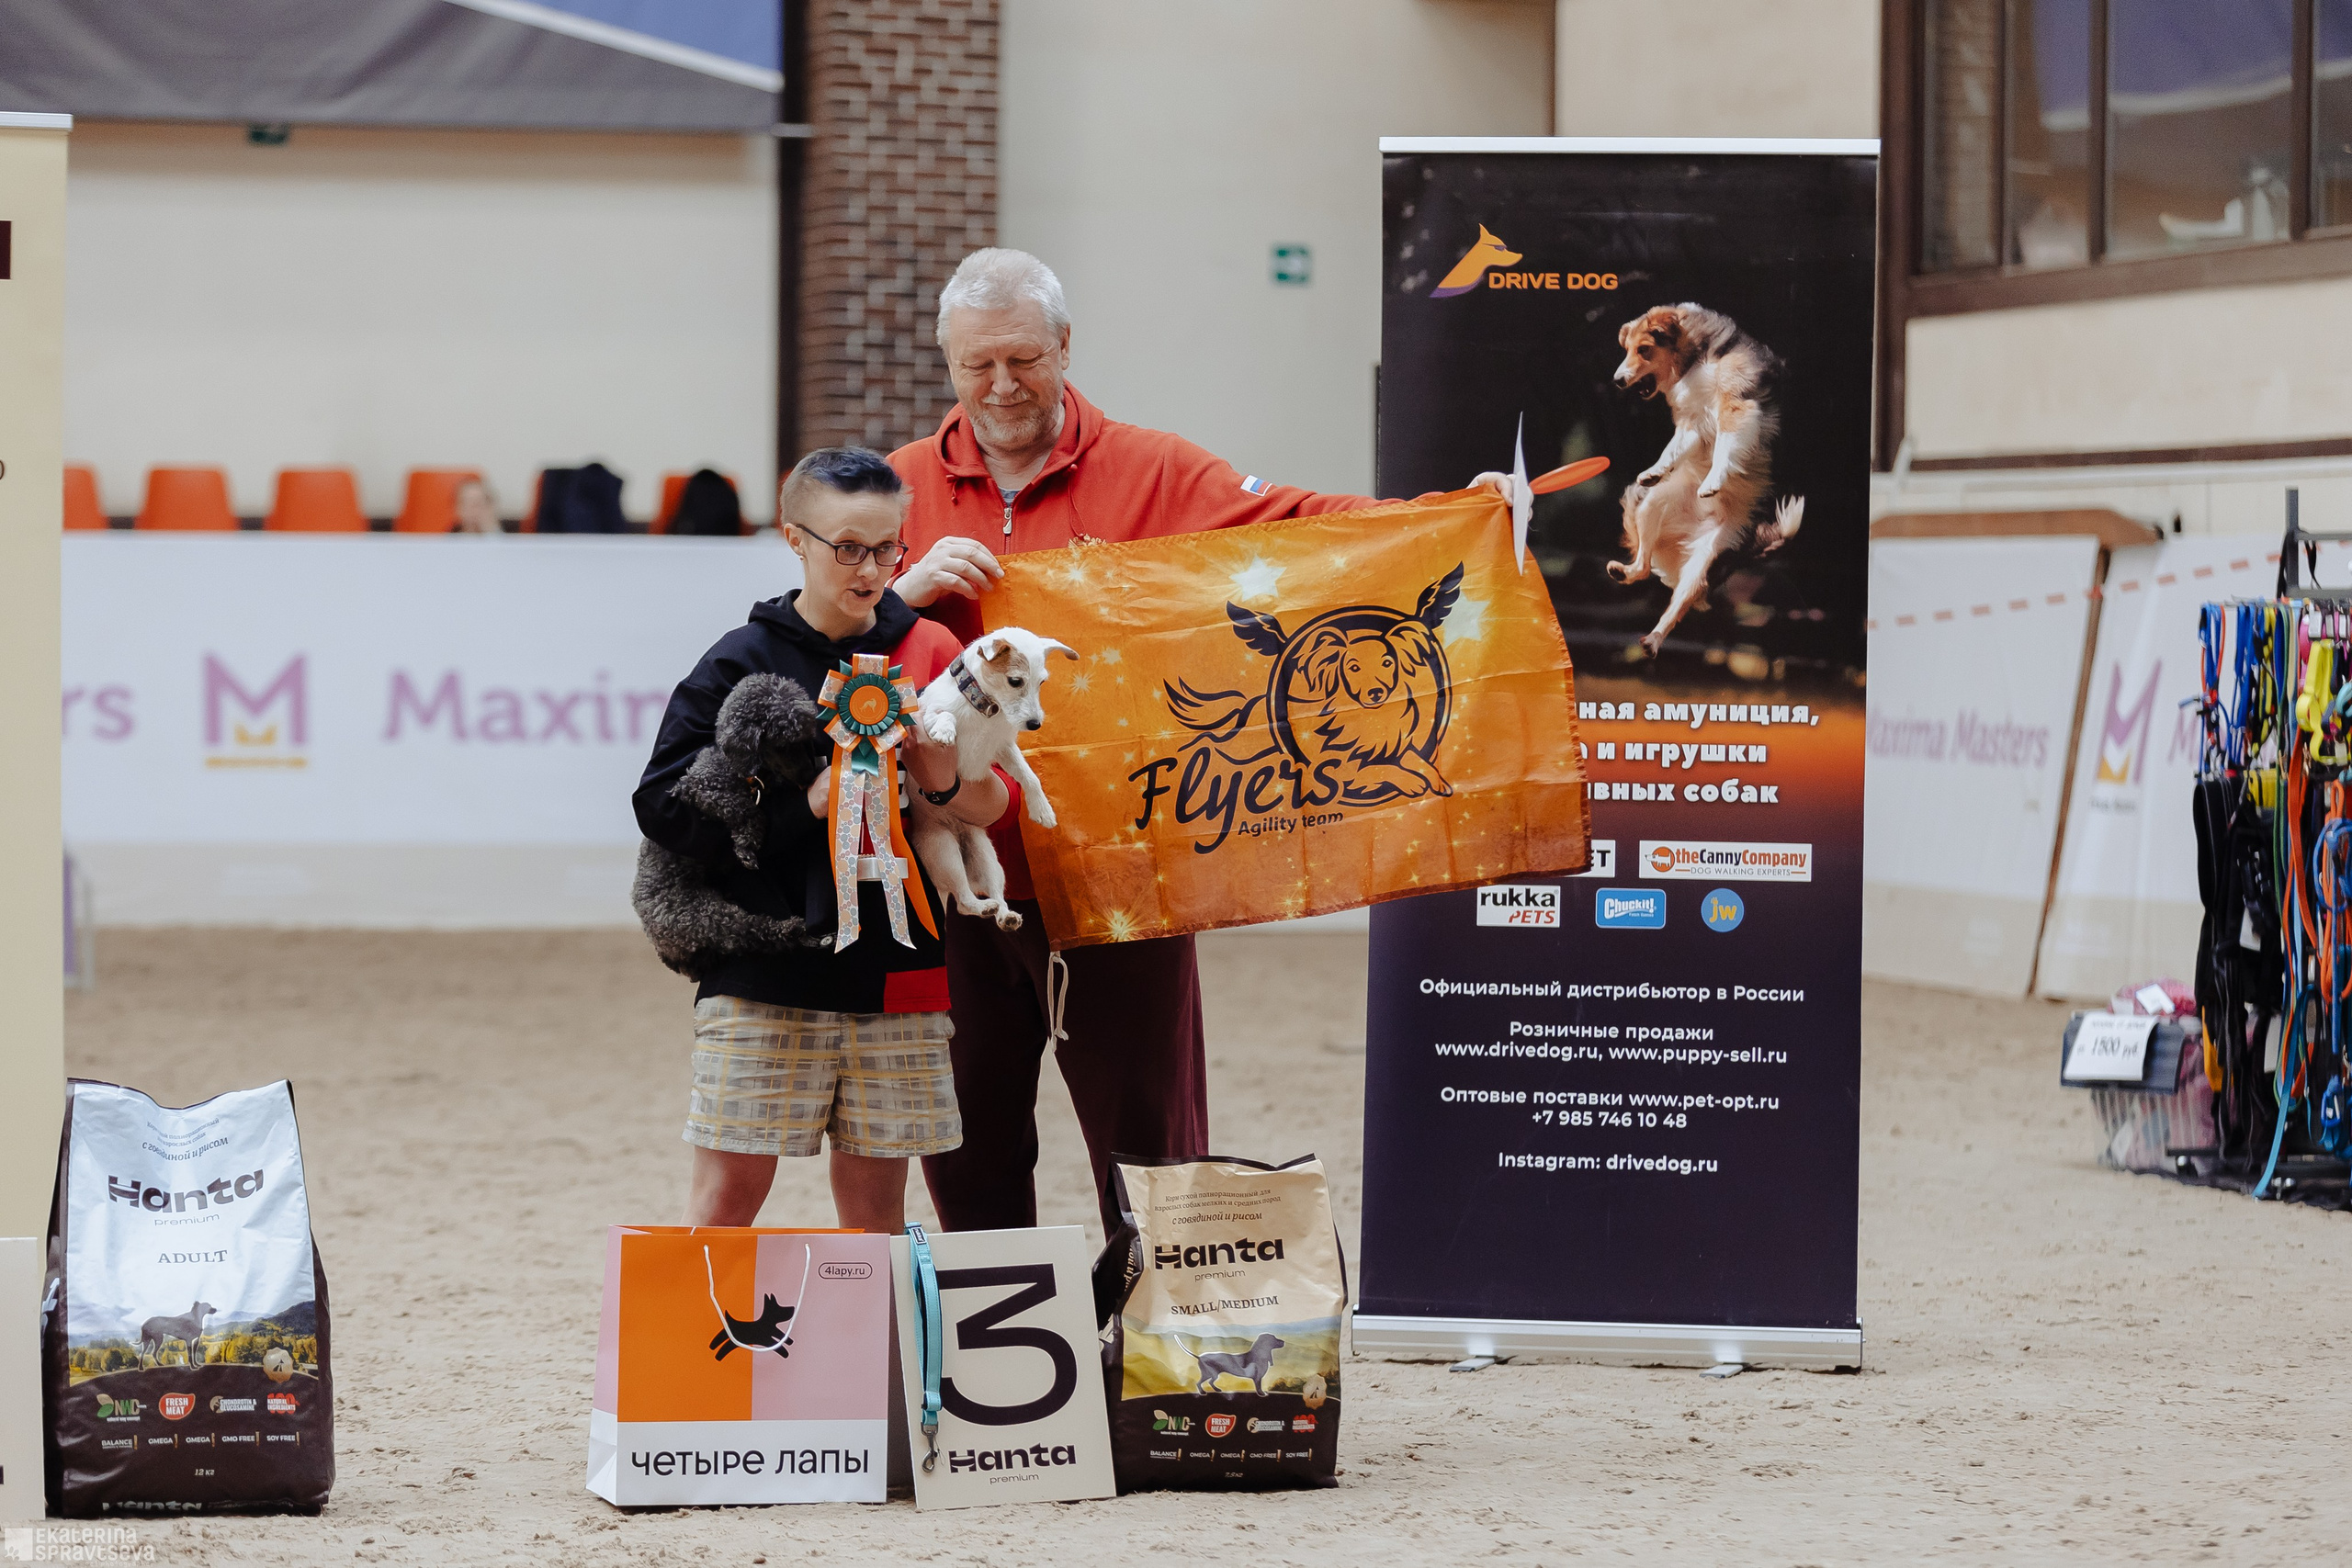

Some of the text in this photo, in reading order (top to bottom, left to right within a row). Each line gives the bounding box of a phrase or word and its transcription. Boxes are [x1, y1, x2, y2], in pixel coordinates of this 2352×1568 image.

[1488, 273, 1619, 290] DRIVE DOG
[380, 668, 671, 748] Maxi
[1644, 703, 1820, 729] амуниция,
[1597, 742, 1616, 761] и
[1625, 742, 1768, 769] игрушки
[1128, 747, 1343, 854] Flyers
[1683, 778, 1779, 804] собак
[1237, 811, 1344, 837] Agility team
[1675, 848, 1807, 868] theCannyCompany
[1690, 867, 1792, 877] DOG WALKING EXPERTS
[1480, 887, 1556, 908] rukka
[1508, 909, 1556, 924] PETS
[1419, 978, 1804, 1002] Официальный дистрибьютор в России
[1510, 1021, 1714, 1042] Розничные продажи
[1435, 1042, 1788, 1065] www.drivedog.ru, www.puppy-sell.ru
[1440, 1087, 1780, 1111] Оптовые поставки www.pet-opt.ru
[1532, 1111, 1688, 1128] +7 985 746 10 48
[198, 1137, 229, 1157] рисом
[1498, 1152, 1719, 1174] Instagram: drivedog.ru
[108, 1169, 264, 1213] Hanta
[154, 1214, 220, 1226] premium
[1177, 1211, 1224, 1224] говядиной
[1231, 1212, 1263, 1223] рисом
[157, 1250, 228, 1264] ADULT
[1154, 1237, 1285, 1270] Hanta
[824, 1265, 866, 1279] 4lapy.ru
[1194, 1269, 1246, 1282] premium
[1170, 1295, 1280, 1315] SMALL/MEDIUM
[938, 1263, 1079, 1427] 3
[165, 1398, 188, 1406] FRESH
[165, 1406, 185, 1416] MEAT
[631, 1449, 869, 1475] четыре лапы
[949, 1442, 1077, 1473] Hanta
[989, 1473, 1040, 1486] premium
